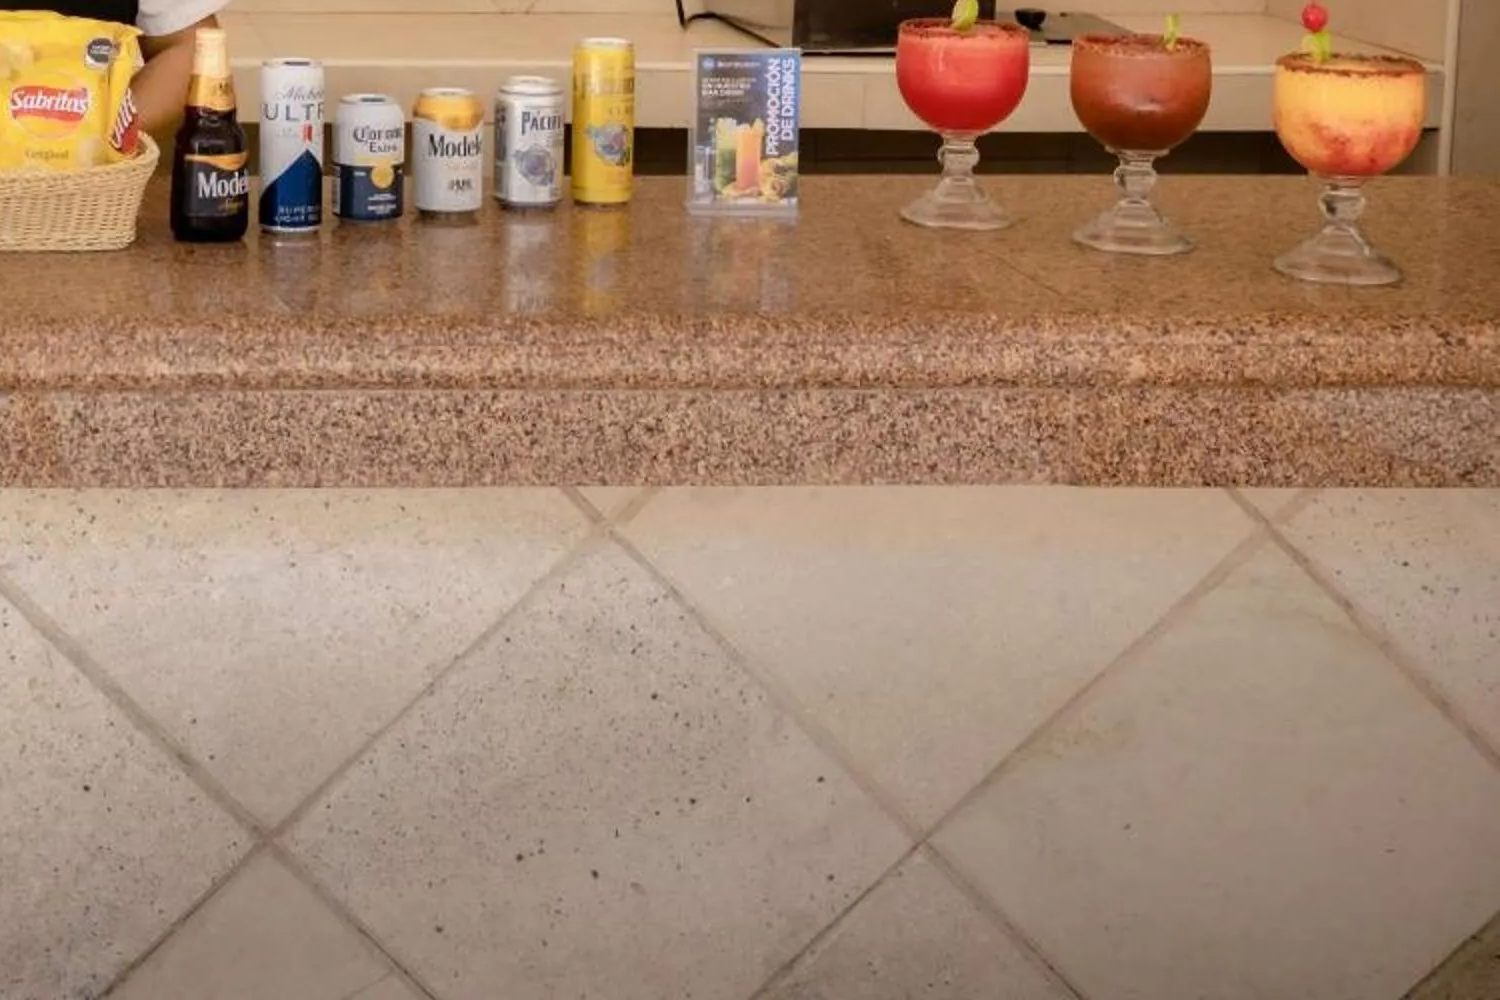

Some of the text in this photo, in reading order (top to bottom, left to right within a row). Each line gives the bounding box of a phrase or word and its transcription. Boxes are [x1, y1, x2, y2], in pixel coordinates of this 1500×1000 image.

[9, 88, 92, 113] Sabritas
[765, 58, 780, 155] PROMOCIÓN
[781, 57, 795, 140] DE DRINKS
[428, 134, 482, 158] Model
